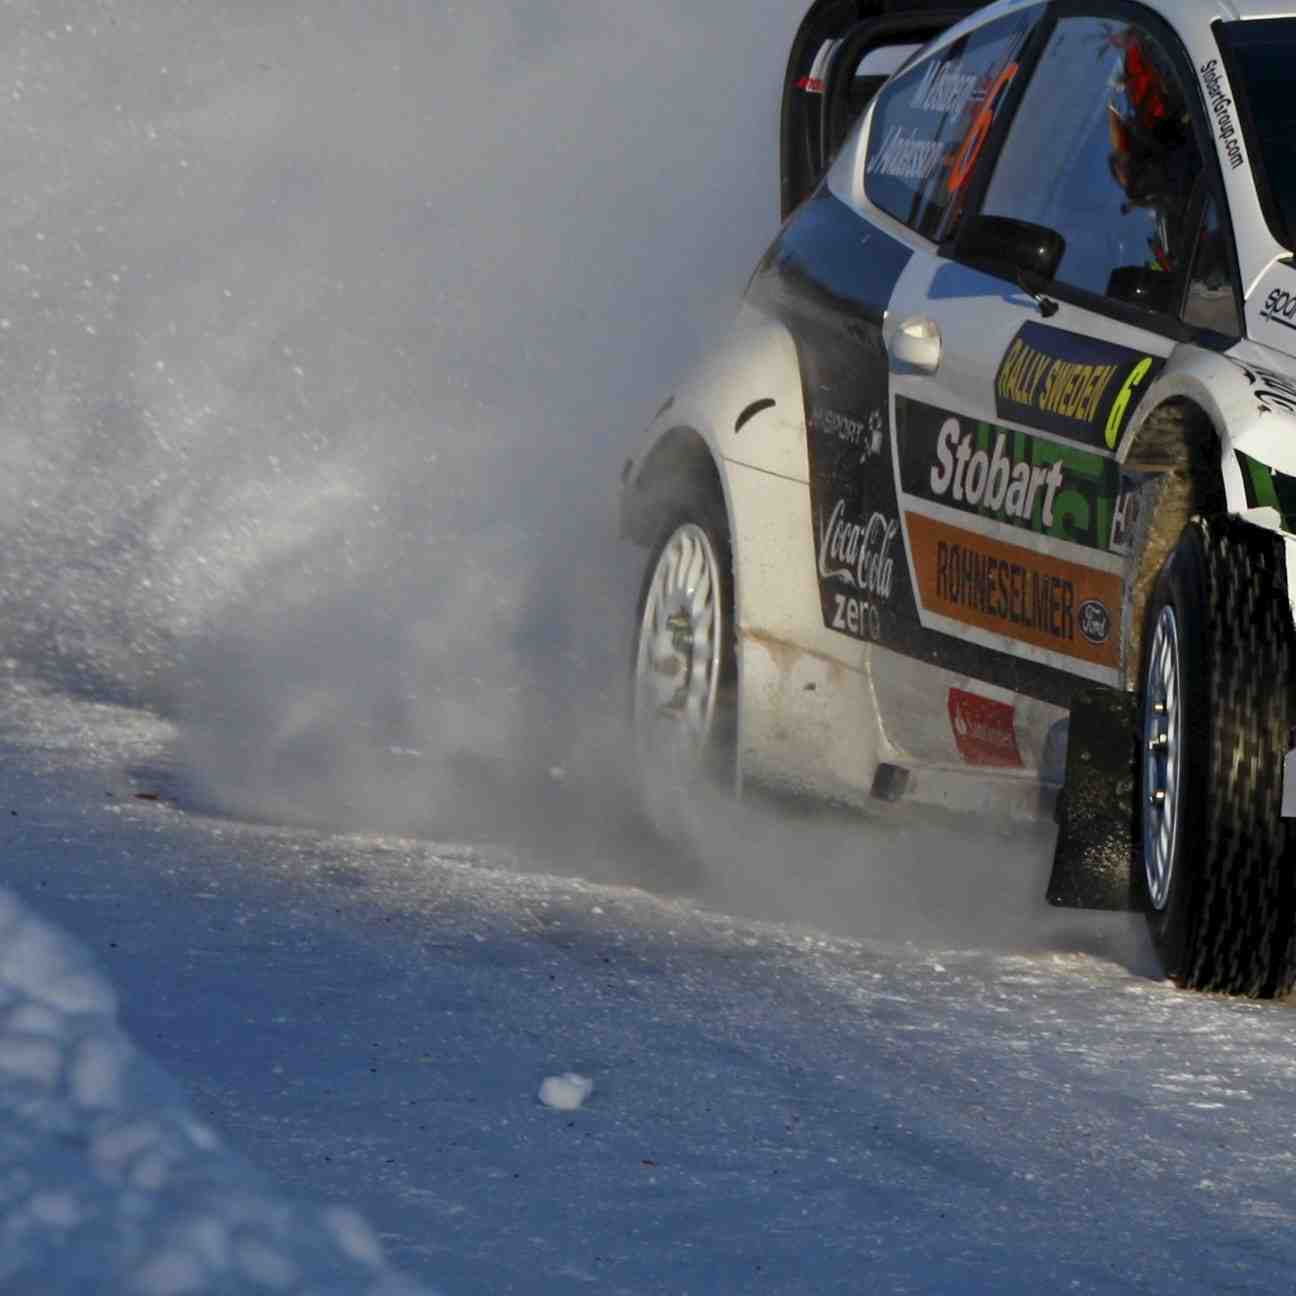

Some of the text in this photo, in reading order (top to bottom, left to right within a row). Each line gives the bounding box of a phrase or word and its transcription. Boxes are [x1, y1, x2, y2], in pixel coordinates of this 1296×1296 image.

[1200, 59, 1245, 170] StobartGroup.com
[999, 337, 1119, 423] RALLY SWEDEN
[1104, 356, 1153, 449] 6
[929, 416, 1064, 527] Stobart
[831, 592, 881, 641] zero
